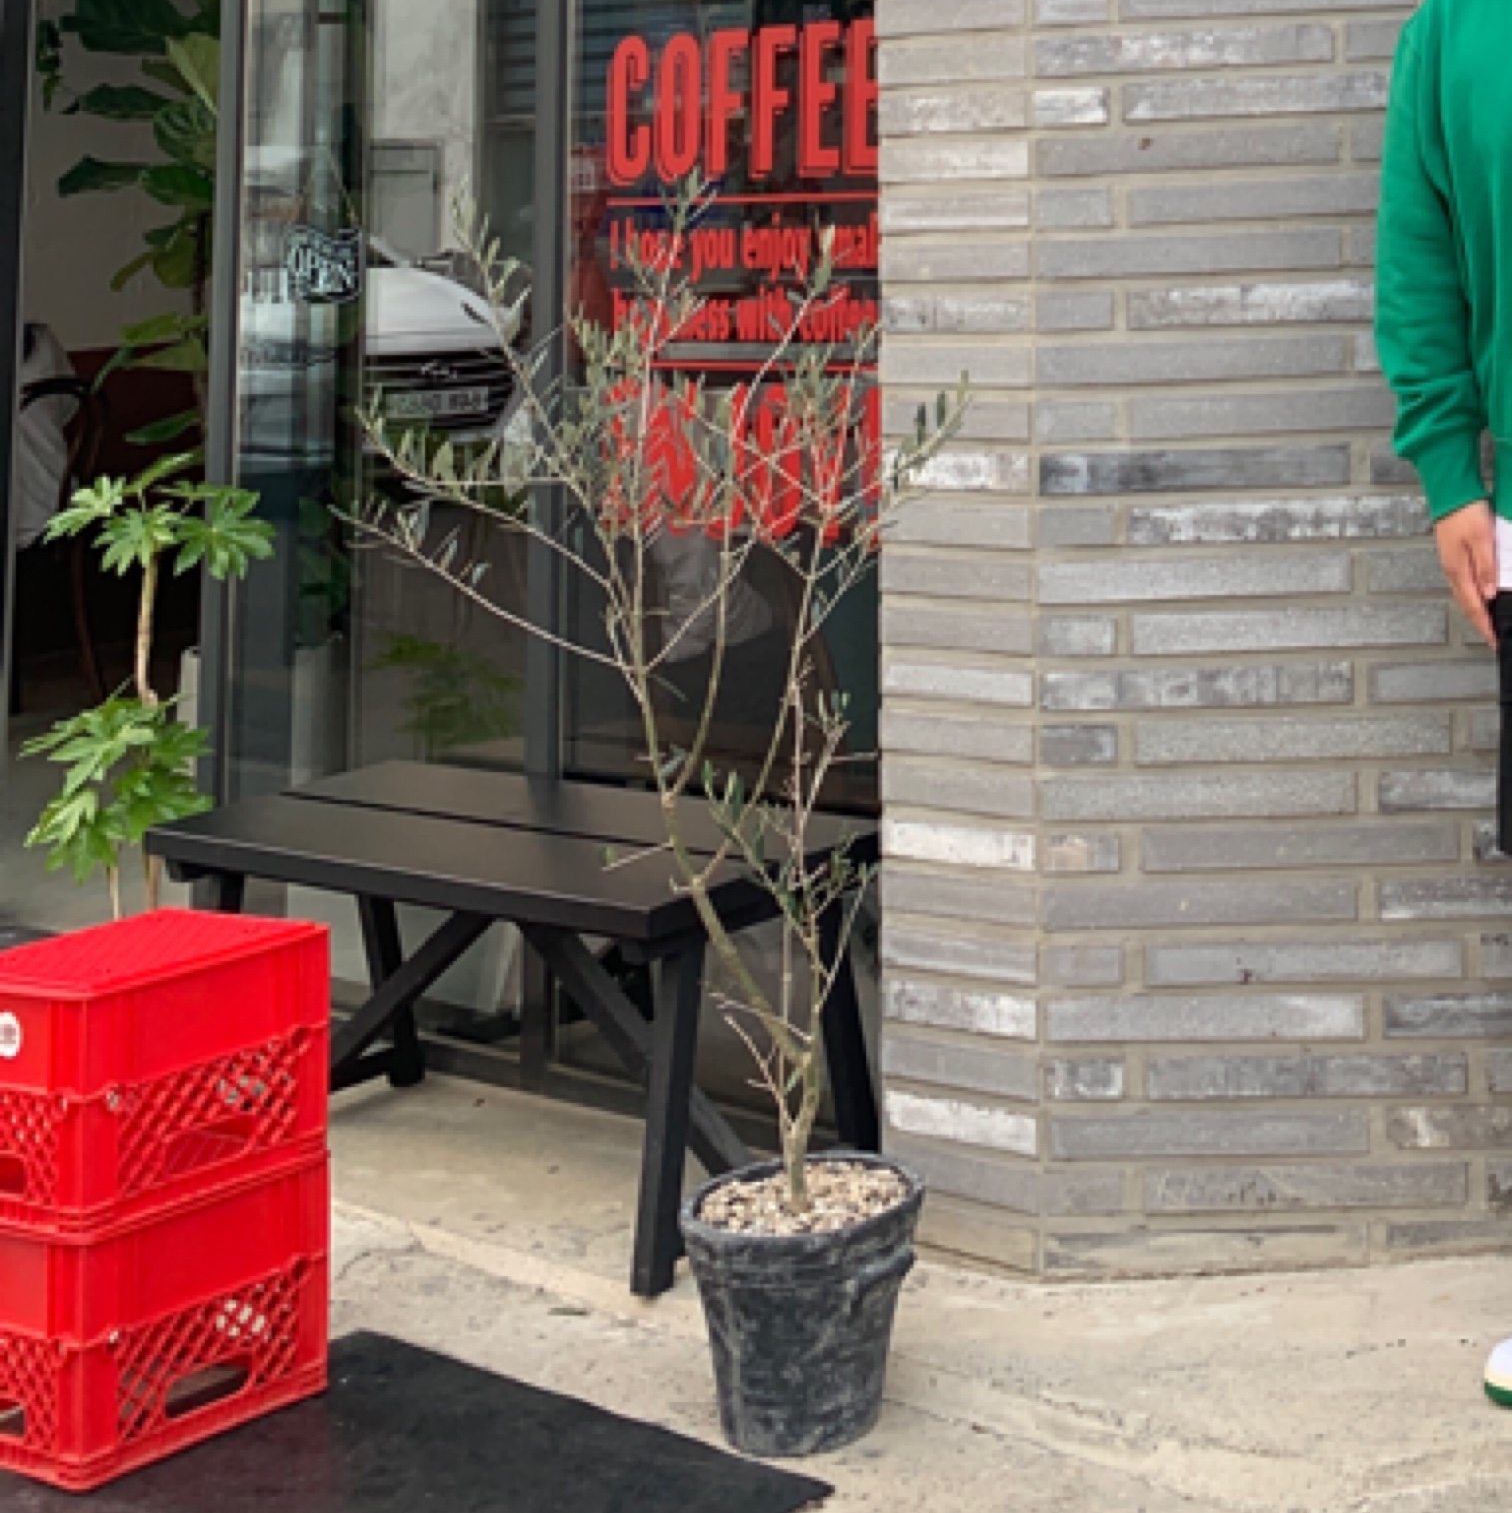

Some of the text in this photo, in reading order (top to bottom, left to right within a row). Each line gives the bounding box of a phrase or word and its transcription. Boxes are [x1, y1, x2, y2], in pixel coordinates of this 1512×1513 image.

[607, 17, 878, 186] COFFEE
[689, 228, 737, 284] you
[743, 211, 812, 284] enjoy
